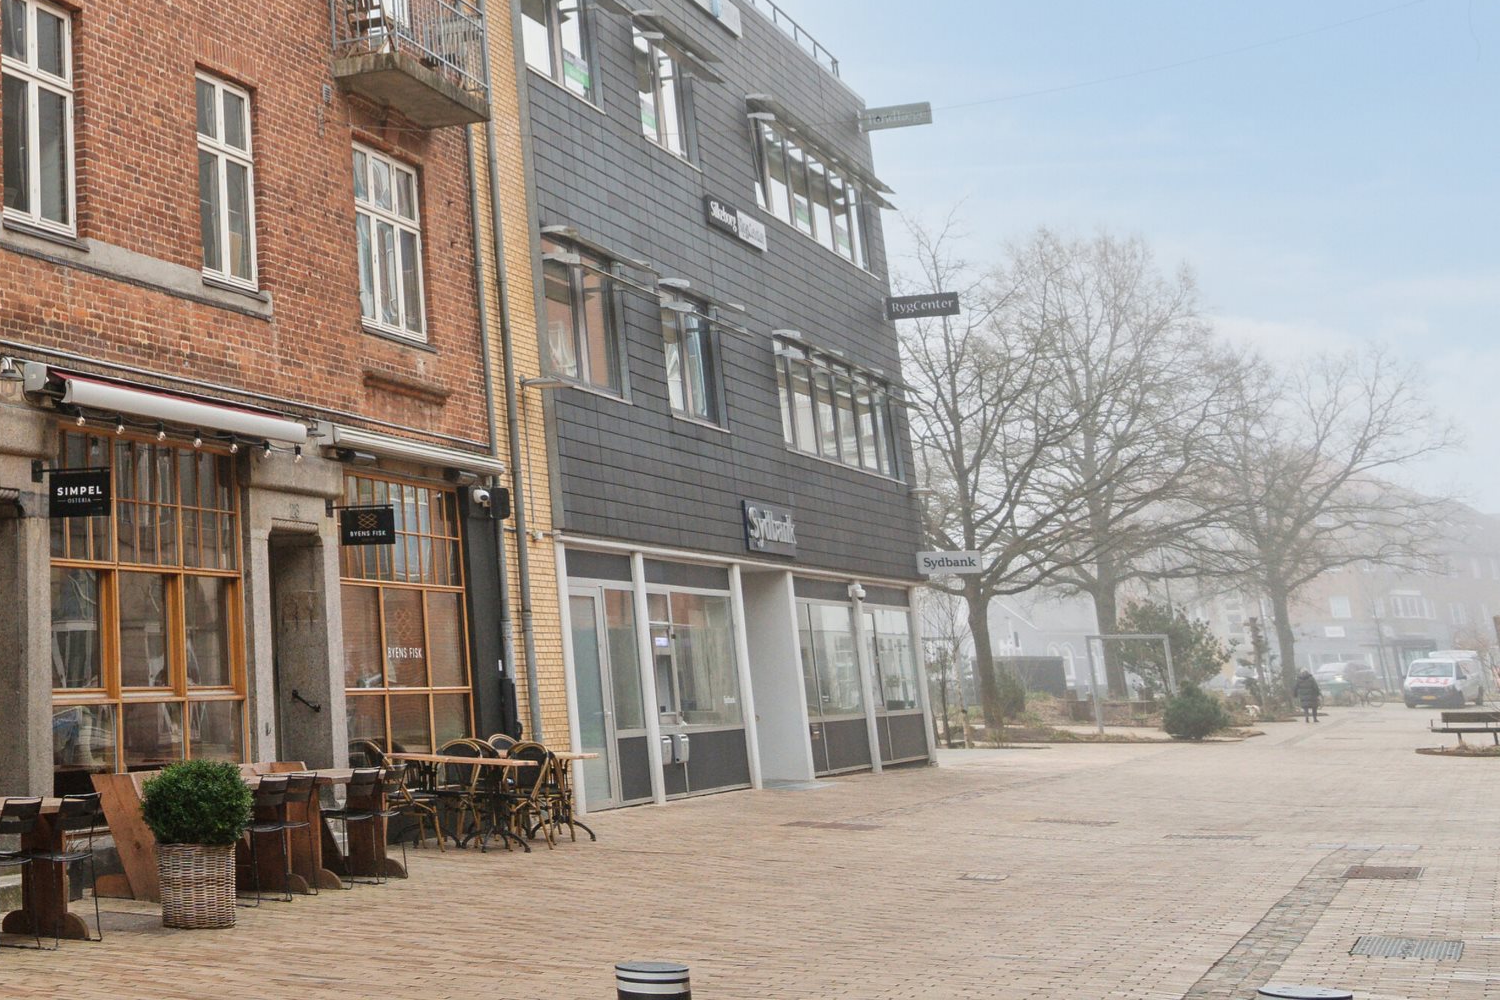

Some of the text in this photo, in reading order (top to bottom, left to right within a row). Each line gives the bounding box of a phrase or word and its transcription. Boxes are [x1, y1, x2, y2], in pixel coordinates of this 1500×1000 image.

[710, 200, 737, 232] Silkeborg
[891, 299, 955, 315] RygCenter
[56, 485, 102, 496] SIMPEL
[748, 506, 798, 548] Sydbank
[923, 556, 977, 570] Sydbank
[387, 646, 422, 659] BYENS FISK
